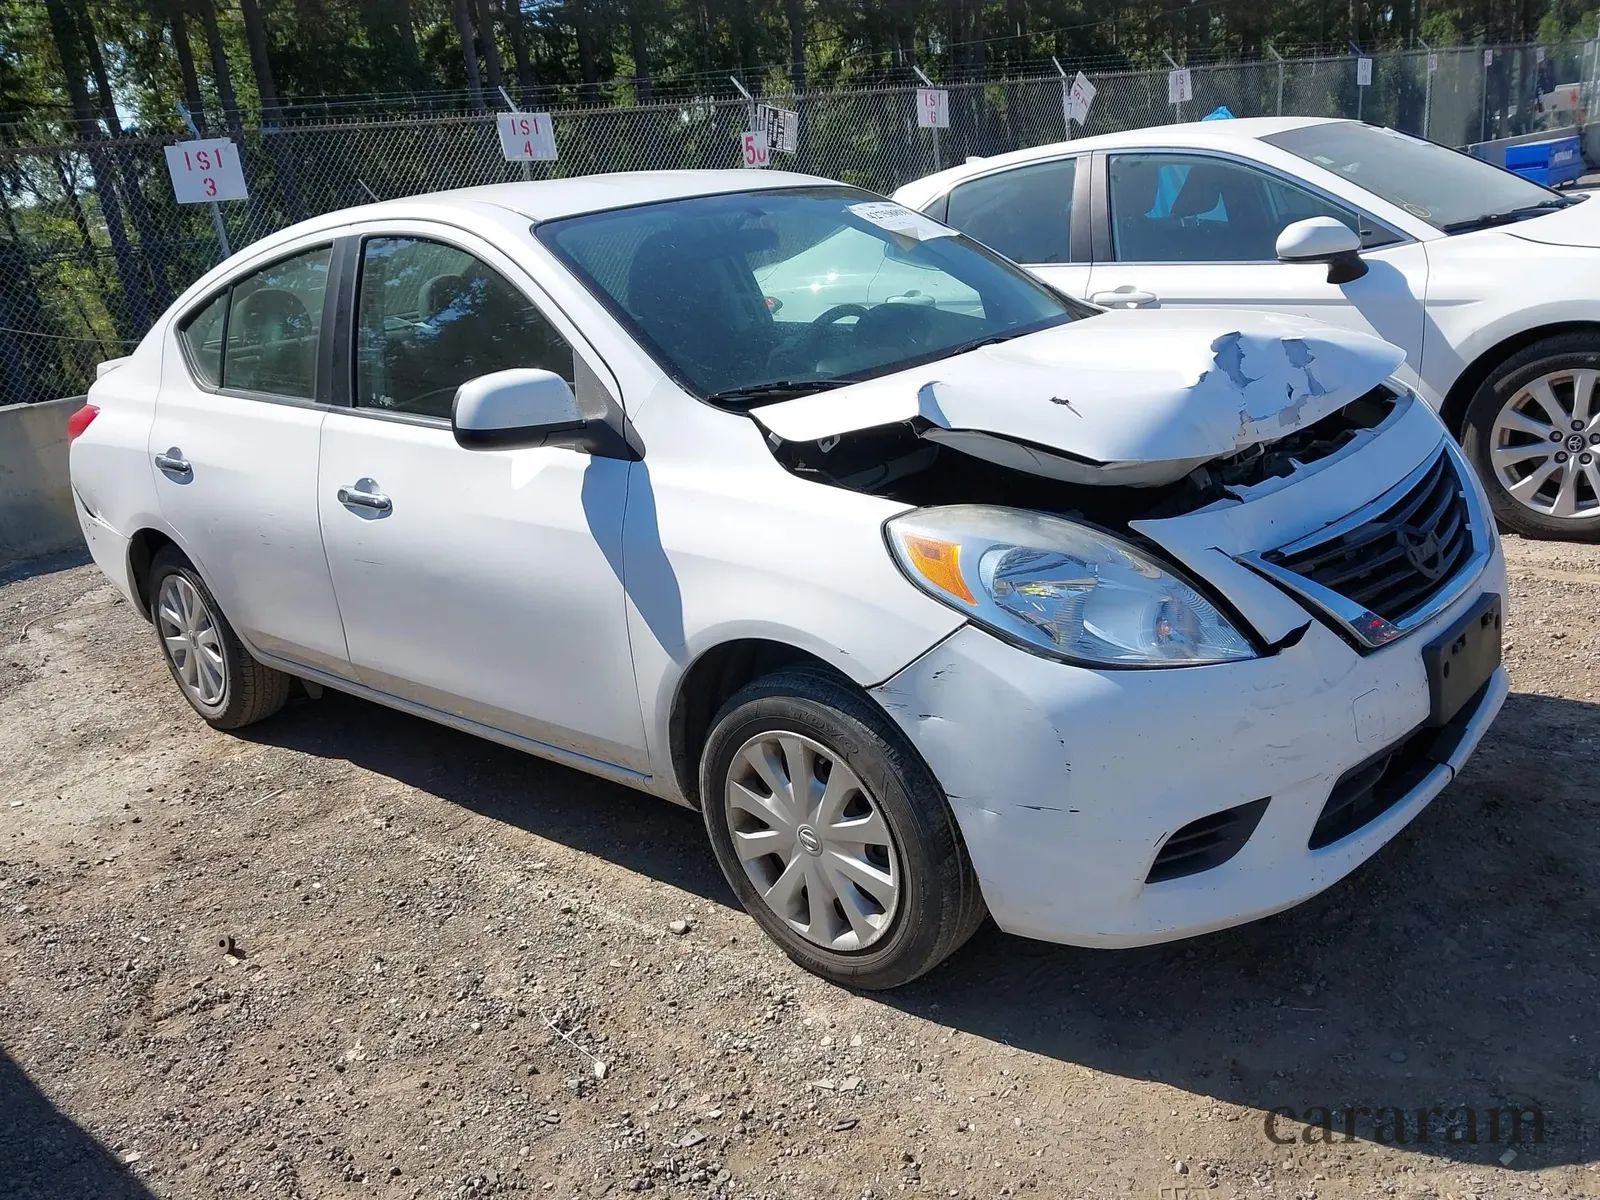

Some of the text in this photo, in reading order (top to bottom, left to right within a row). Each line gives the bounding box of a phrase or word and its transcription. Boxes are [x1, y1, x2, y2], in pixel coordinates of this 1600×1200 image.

[1179, 88, 1185, 99] 8
[1067, 102, 1073, 115] 7
[930, 111, 937, 124] 6
[524, 140, 533, 157] 4
[776, 133, 784, 150] SONS
[203, 177, 218, 198] 3
[788, 707, 859, 754] TOYO
